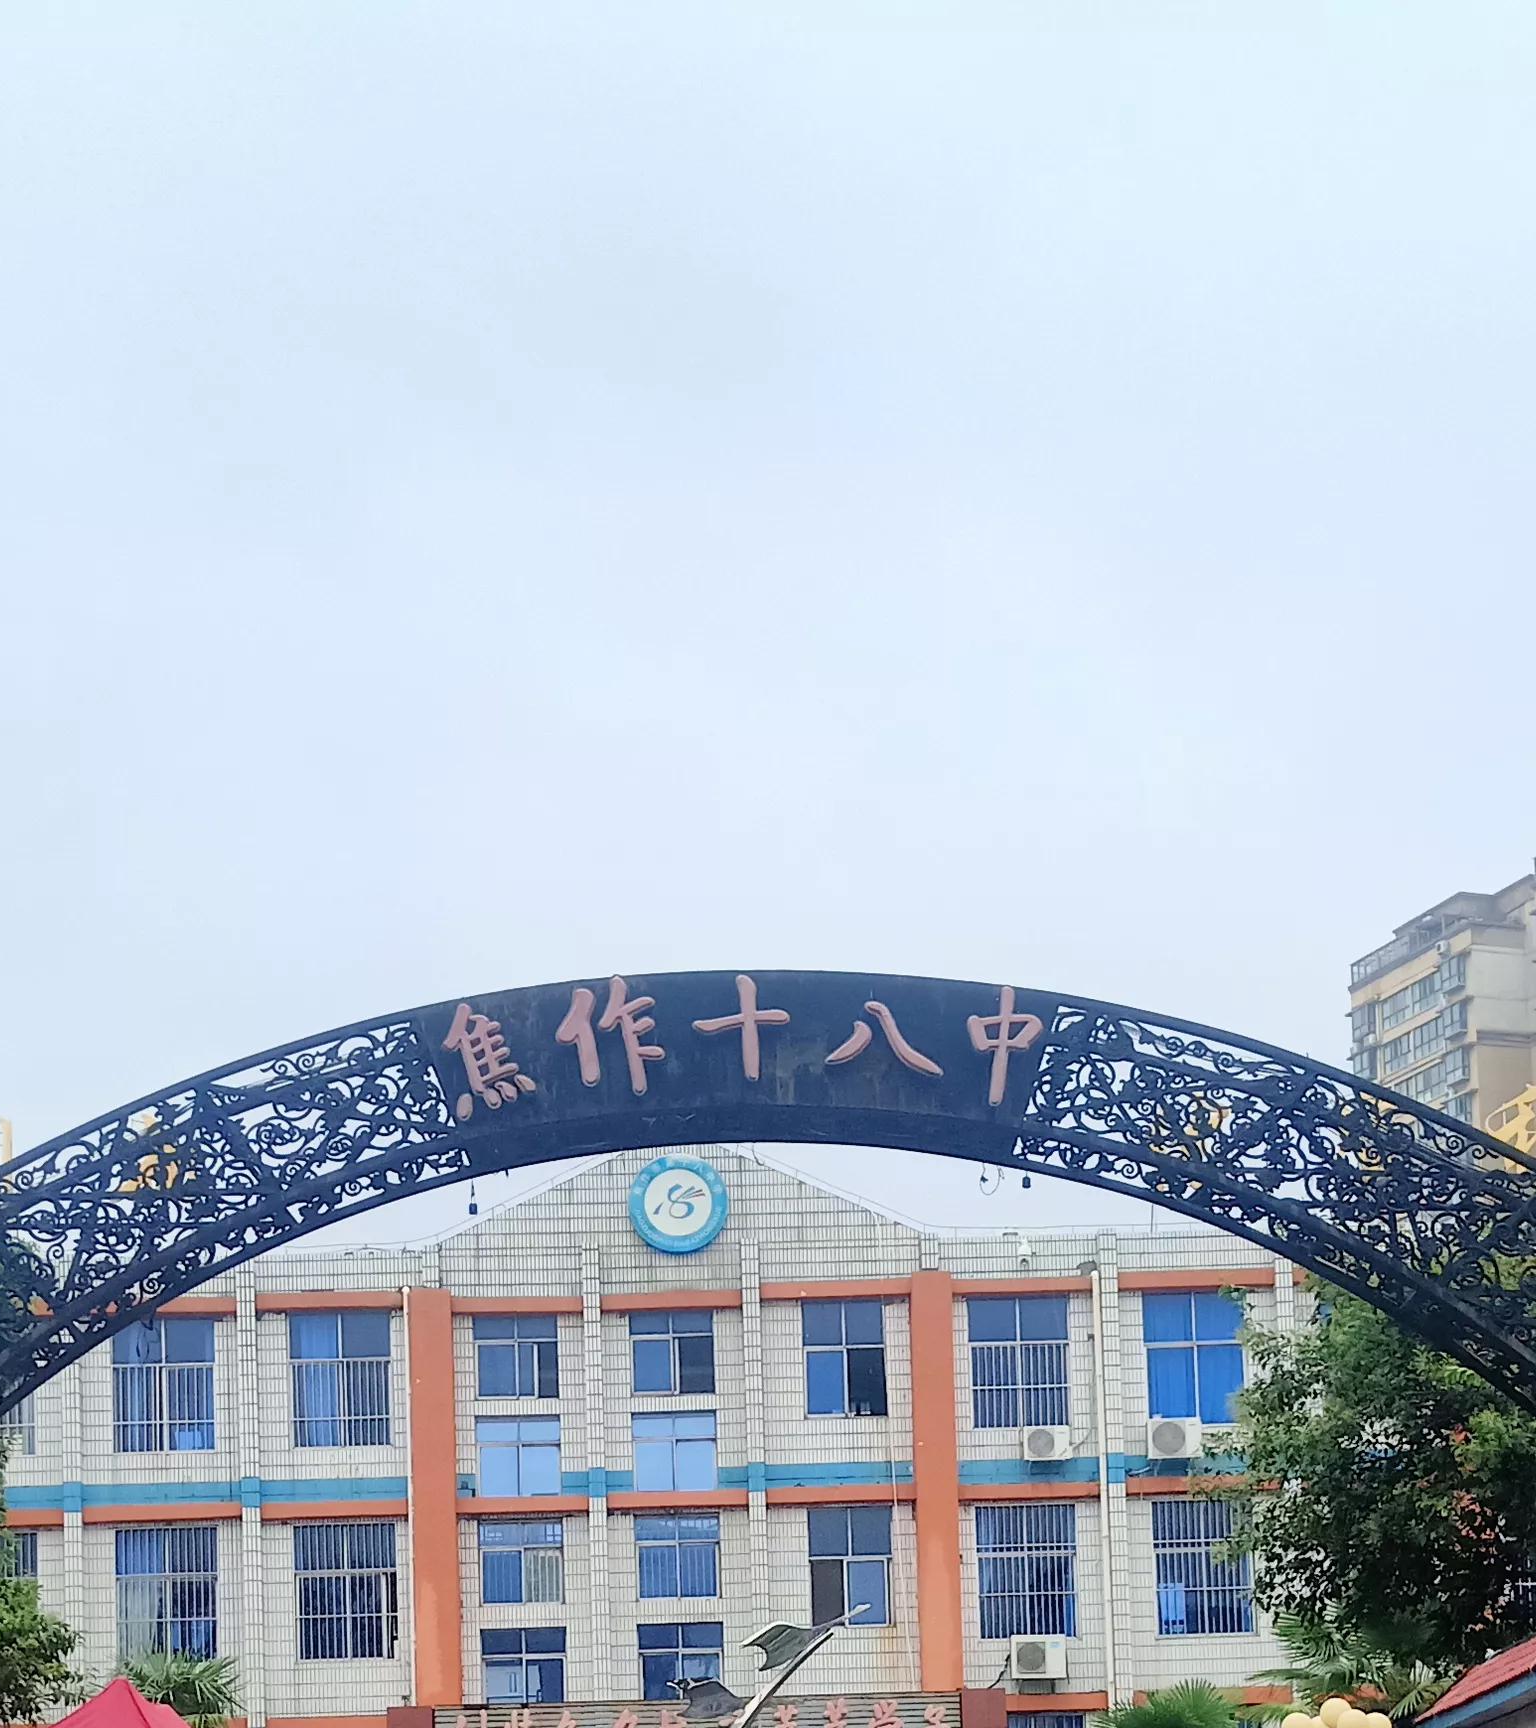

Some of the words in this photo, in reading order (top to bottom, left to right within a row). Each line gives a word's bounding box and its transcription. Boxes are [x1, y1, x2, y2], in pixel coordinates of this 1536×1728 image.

[441, 973, 1045, 1121] 焦作十八中
